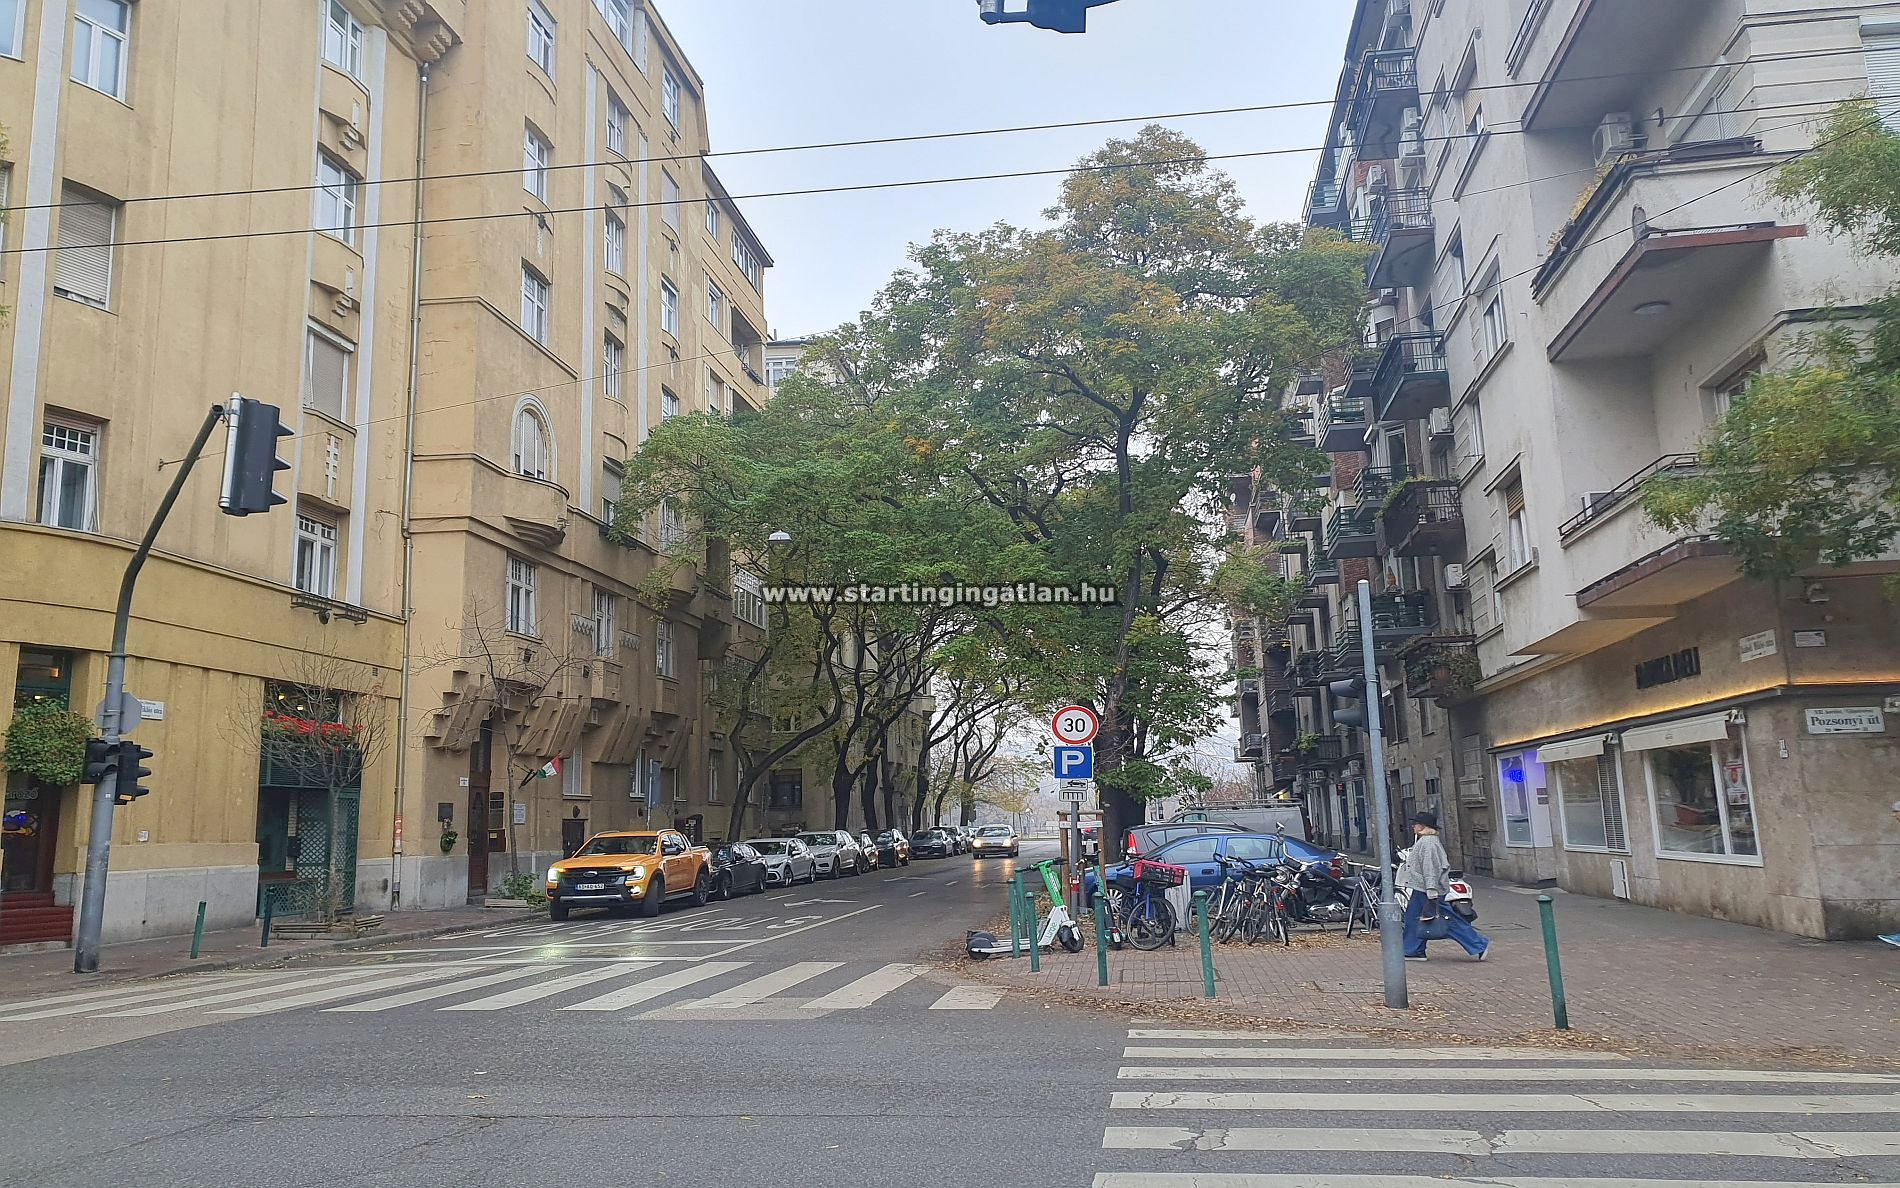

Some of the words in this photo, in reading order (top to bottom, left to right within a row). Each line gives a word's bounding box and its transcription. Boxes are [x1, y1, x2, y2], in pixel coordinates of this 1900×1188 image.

[1064, 718, 1086, 733] 30
[1810, 715, 1864, 727] Pozsonyi
[1866, 714, 1880, 725] út
[1061, 750, 1085, 775] P
